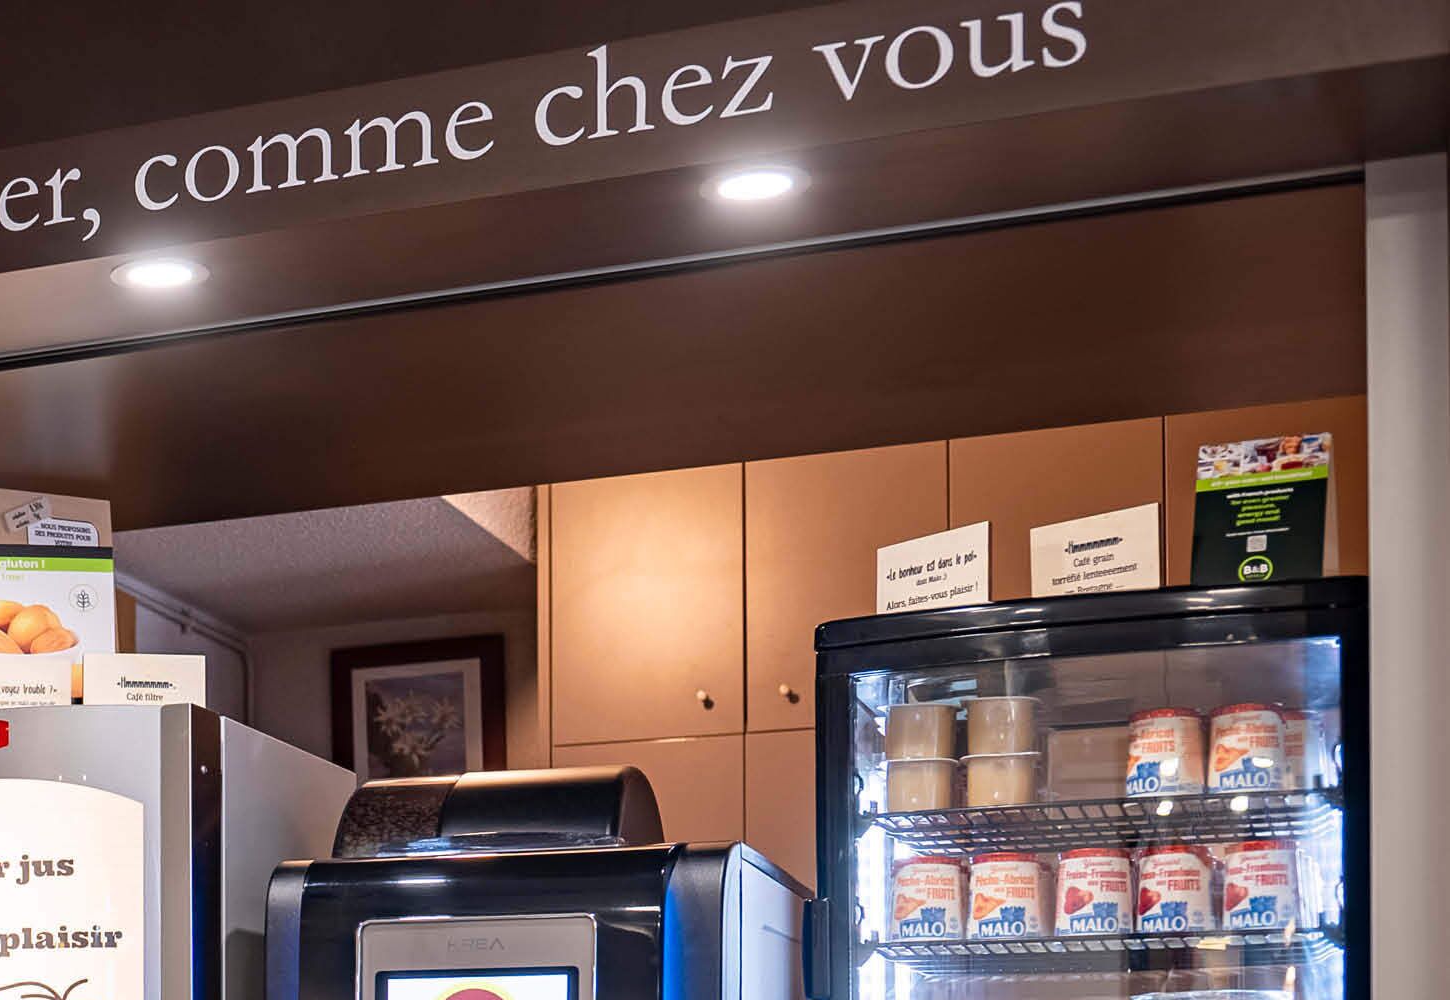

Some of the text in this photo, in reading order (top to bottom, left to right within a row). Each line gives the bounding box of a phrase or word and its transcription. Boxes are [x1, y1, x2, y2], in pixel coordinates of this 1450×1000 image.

[134, 100, 495, 211] comme
[533, 44, 774, 146] chez
[812, 0, 1088, 102] vous
[1073, 554, 1114, 567] Café grain
[126, 692, 163, 701] Café filtre
[1221, 772, 1268, 789] MALO
[16, 854, 75, 885] jus
[1072, 917, 1117, 932] MALO
[1143, 916, 1186, 931] MALO
[1231, 911, 1275, 926] MALO
[902, 921, 944, 937] MALO
[981, 921, 1024, 937] MALO
